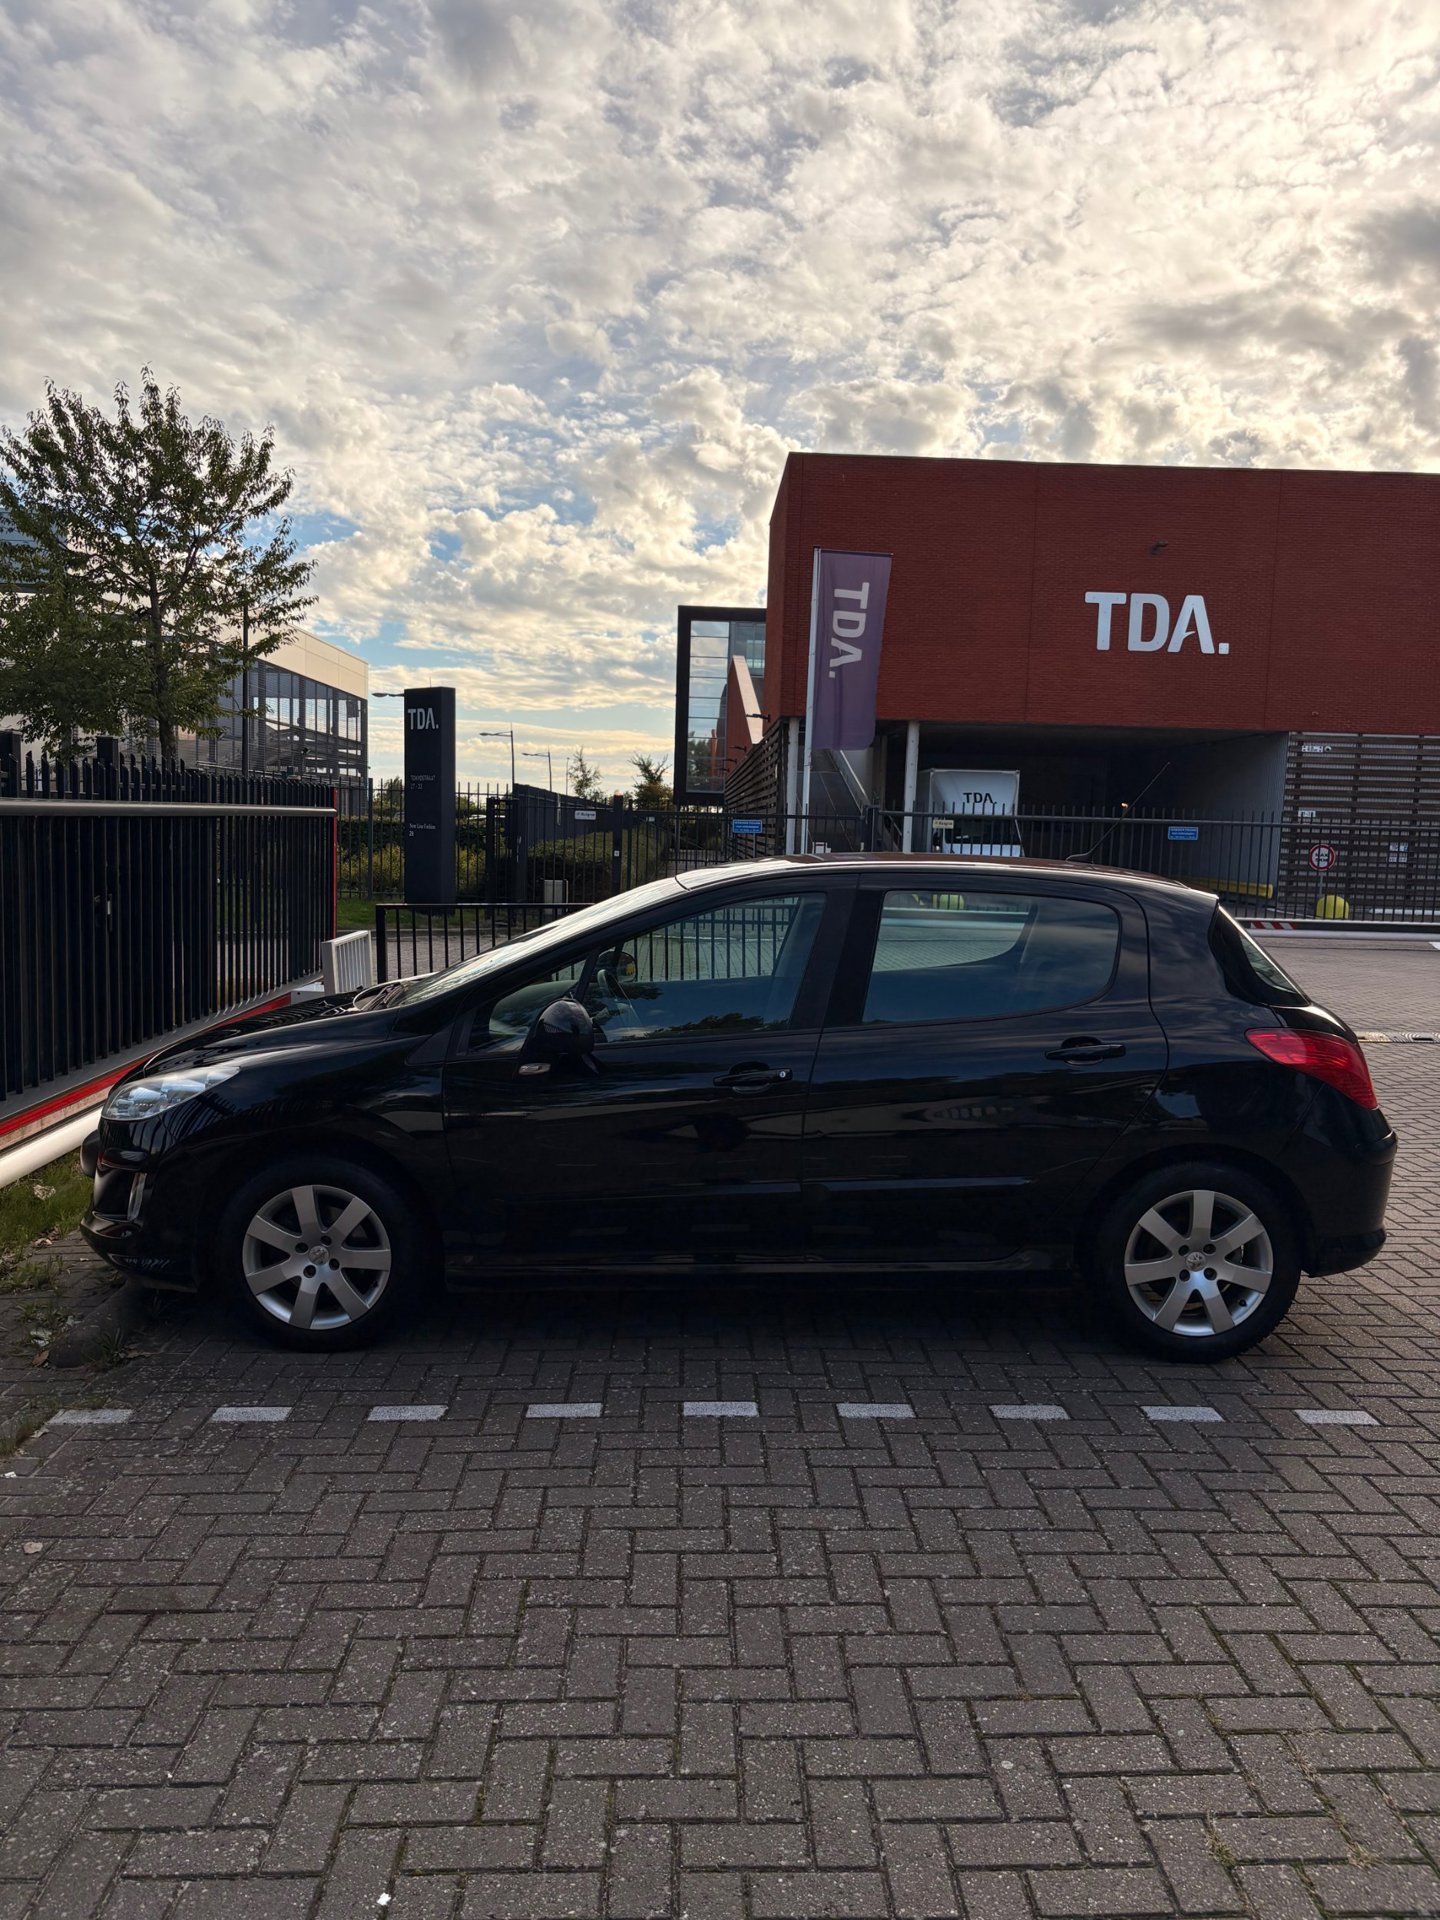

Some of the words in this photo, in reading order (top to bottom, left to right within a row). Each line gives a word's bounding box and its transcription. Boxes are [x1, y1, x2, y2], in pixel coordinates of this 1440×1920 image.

[829, 582, 869, 678] TDA.
[1085, 592, 1229, 654] TDA.
[408, 707, 439, 730] TDA.
